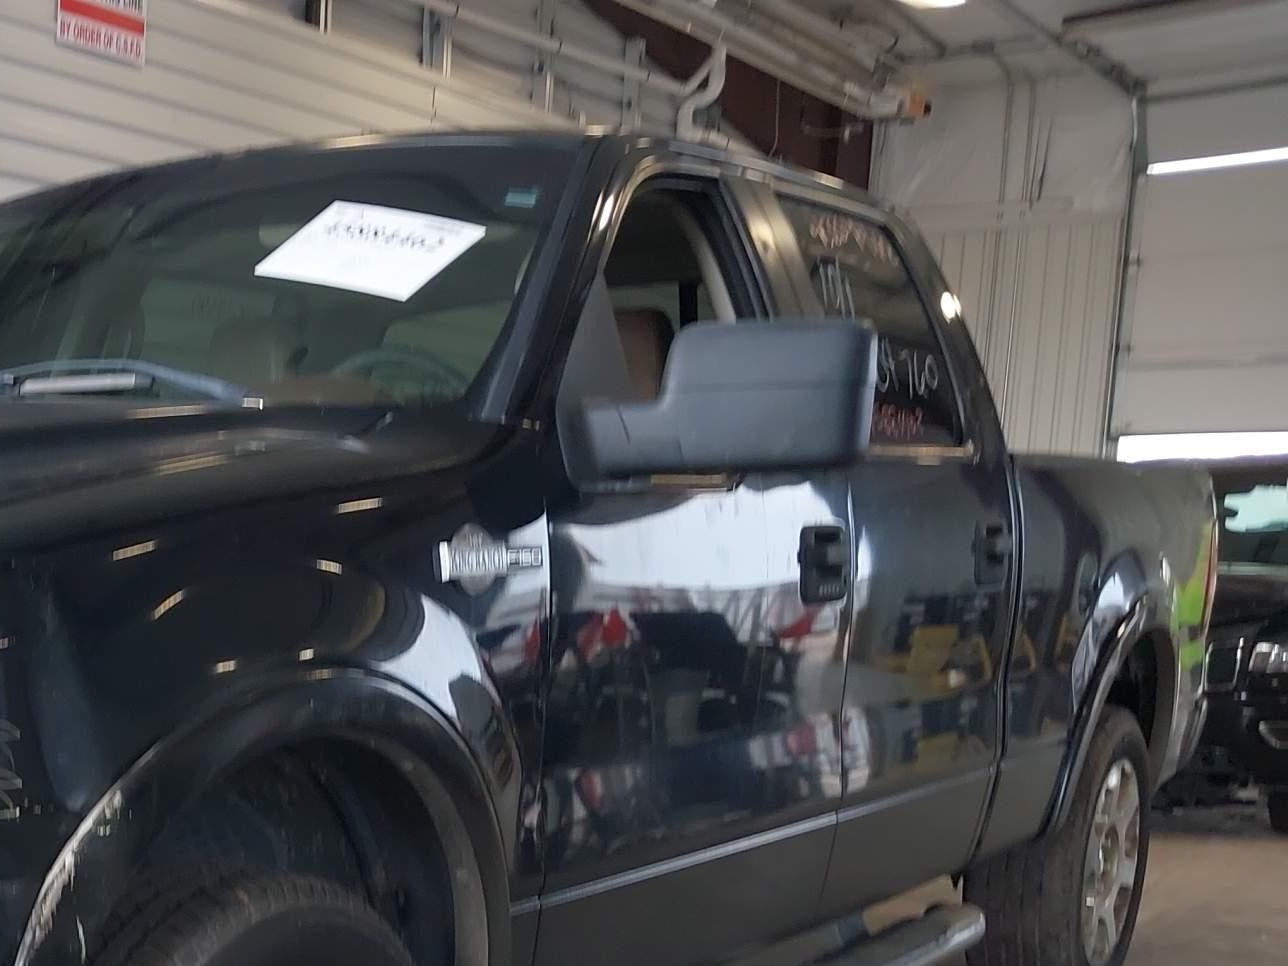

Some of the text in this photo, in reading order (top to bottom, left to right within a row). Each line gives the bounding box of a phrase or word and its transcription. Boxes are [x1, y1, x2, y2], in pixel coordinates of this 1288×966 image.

[59, 18, 72, 38] BY
[73, 22, 102, 49] ORDER
[103, 30, 114, 51] OF
